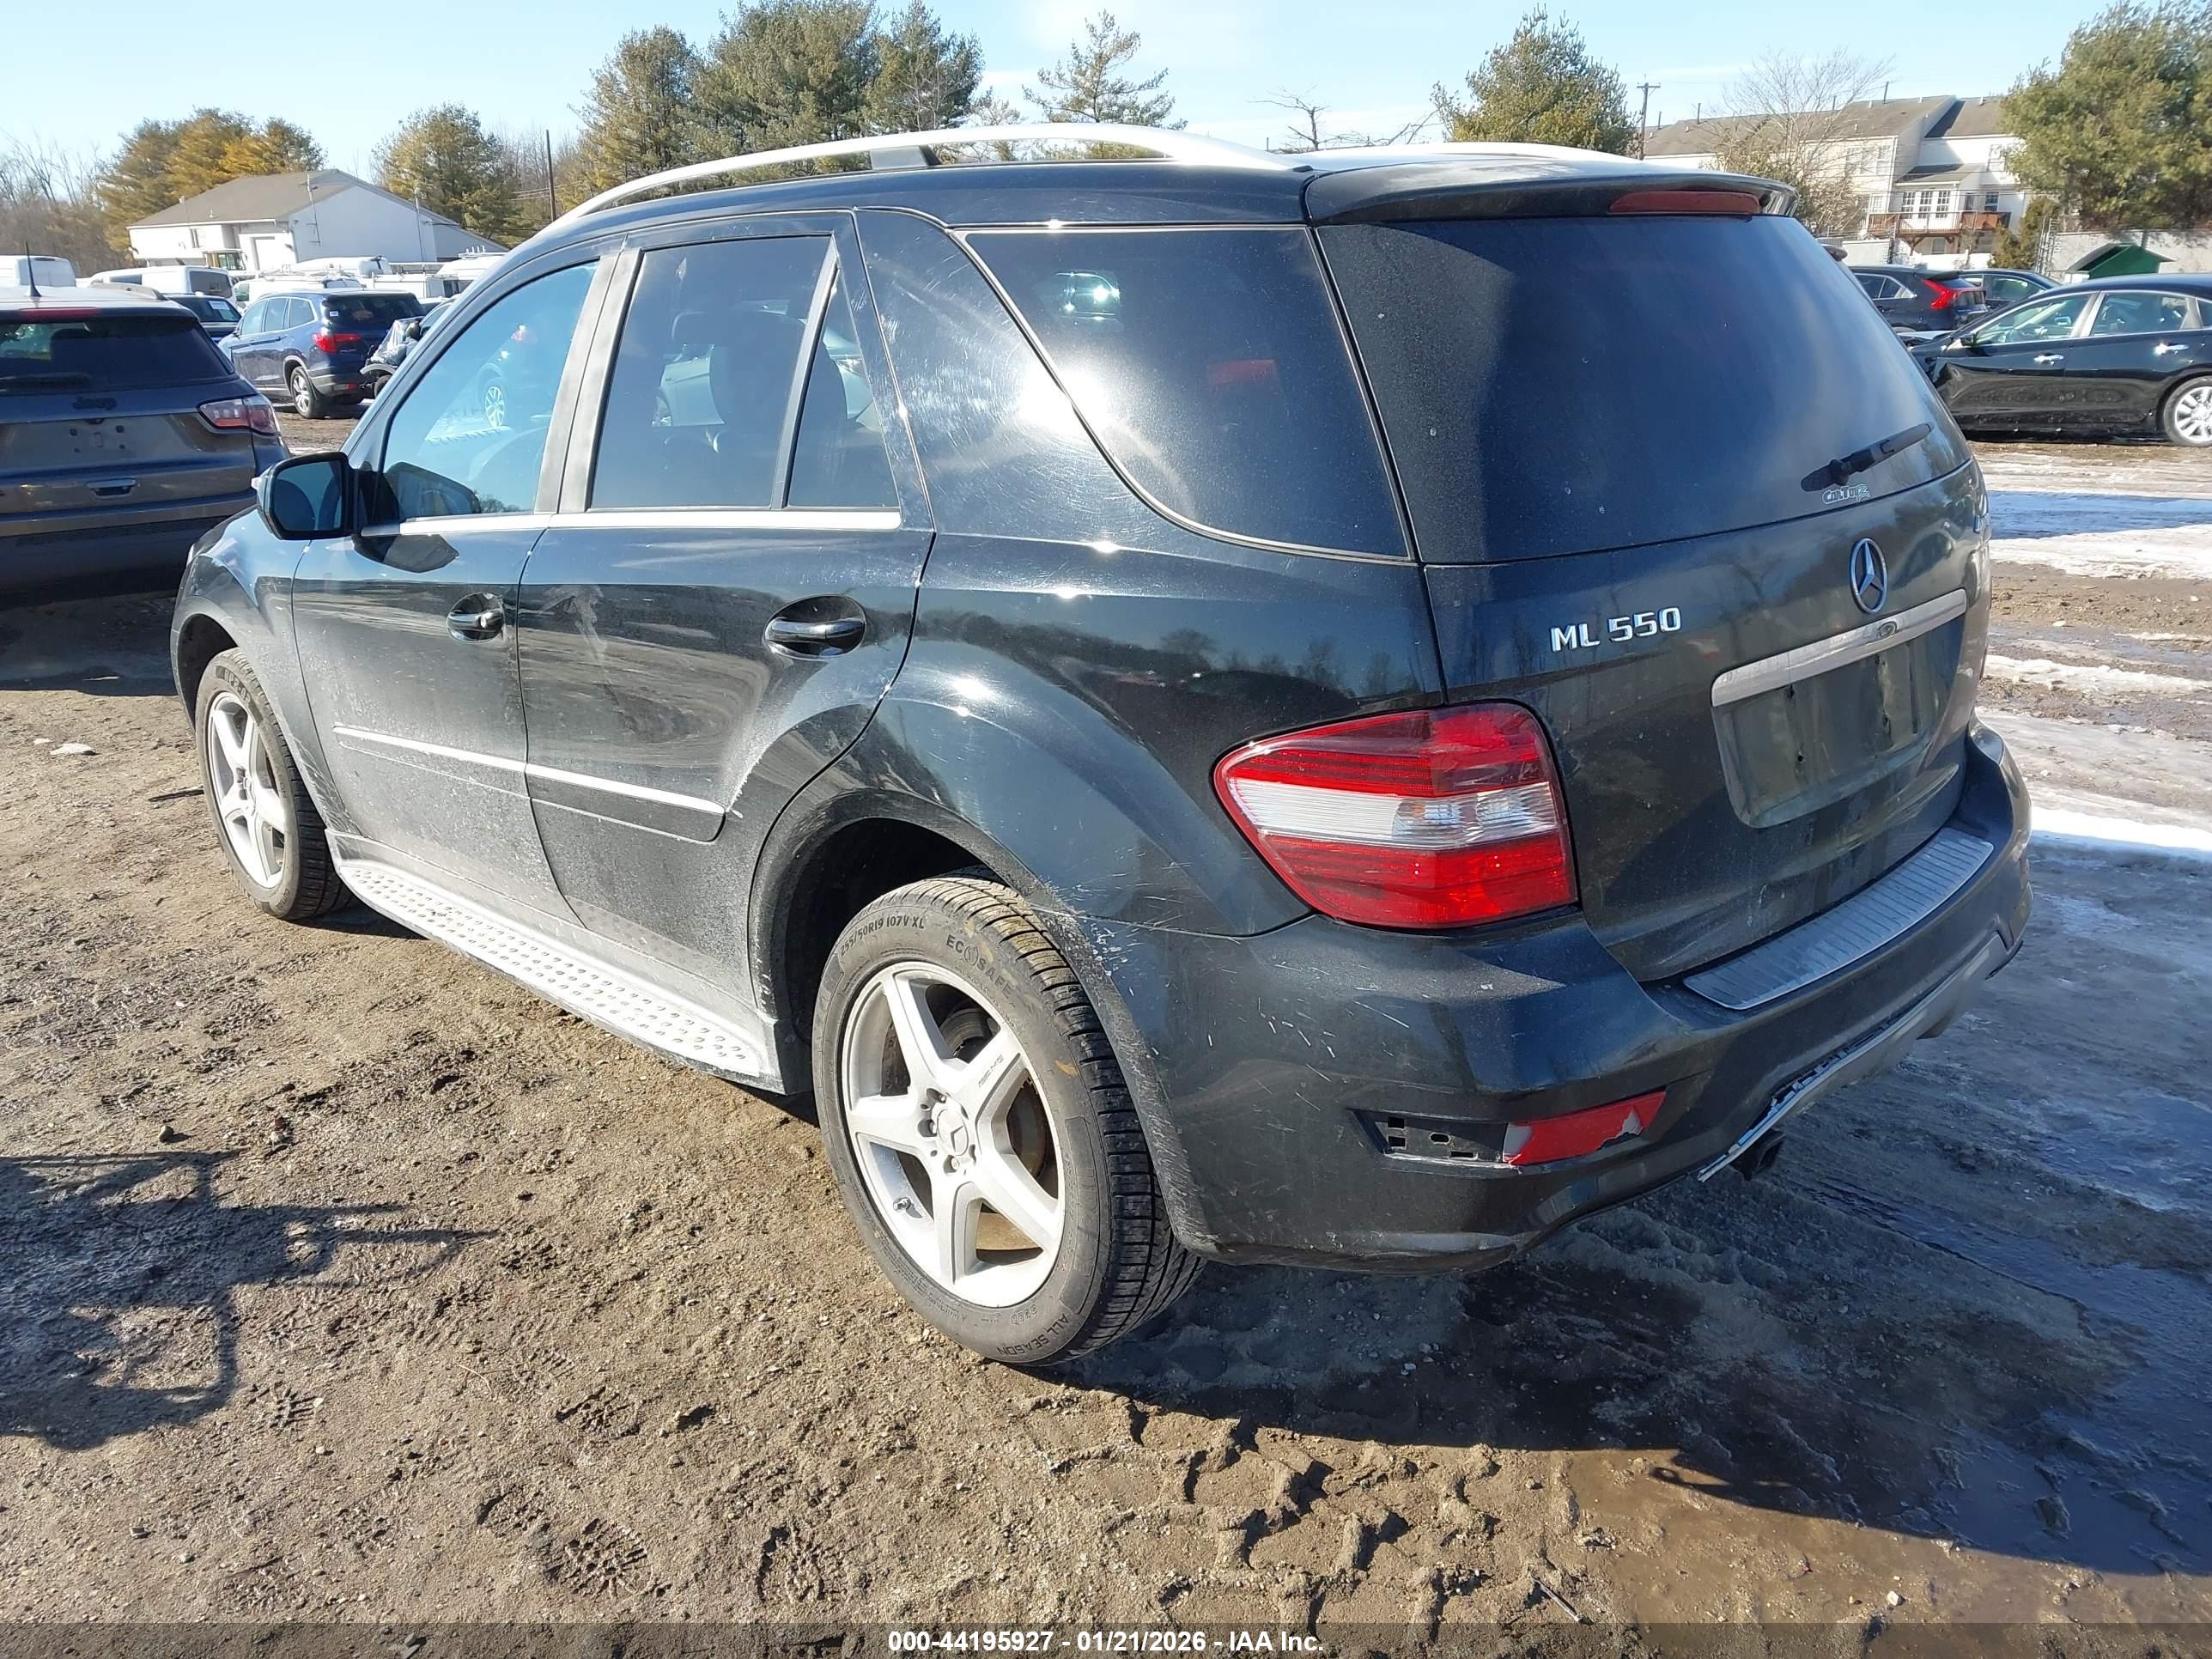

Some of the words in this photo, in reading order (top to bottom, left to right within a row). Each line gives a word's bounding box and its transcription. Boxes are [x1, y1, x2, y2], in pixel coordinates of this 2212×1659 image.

[1550, 623, 1601, 653] ML
[1607, 606, 1681, 642] 550
[911, 916, 926, 930] XL
[1046, 1313, 1069, 1336] ALL
[996, 1334, 1050, 1356] SEASON
